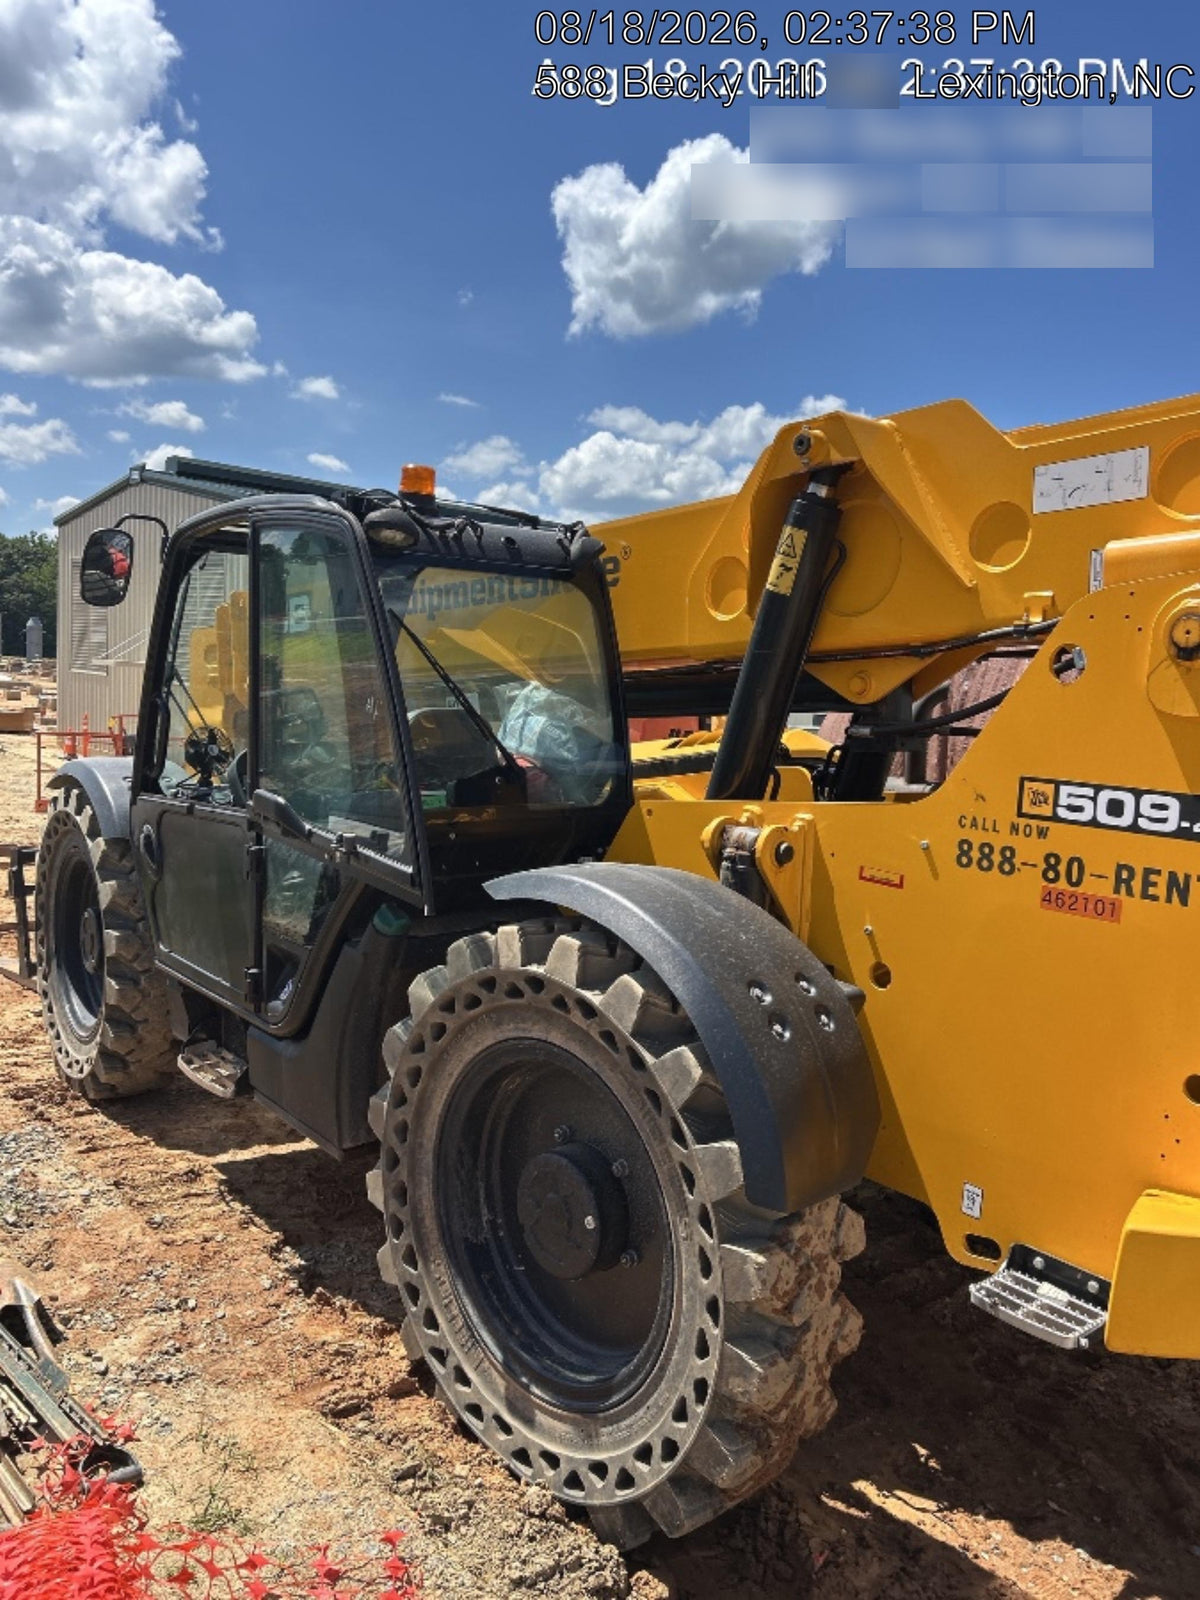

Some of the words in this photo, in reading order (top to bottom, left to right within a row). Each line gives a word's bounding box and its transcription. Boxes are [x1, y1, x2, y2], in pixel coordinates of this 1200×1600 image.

[957, 814, 1001, 834] CALL
[1010, 821, 1051, 840] NOW
[1056, 784, 1200, 833] 509-
[956, 838, 1200, 908] 888-80-REN
[1041, 889, 1116, 918] 462101
